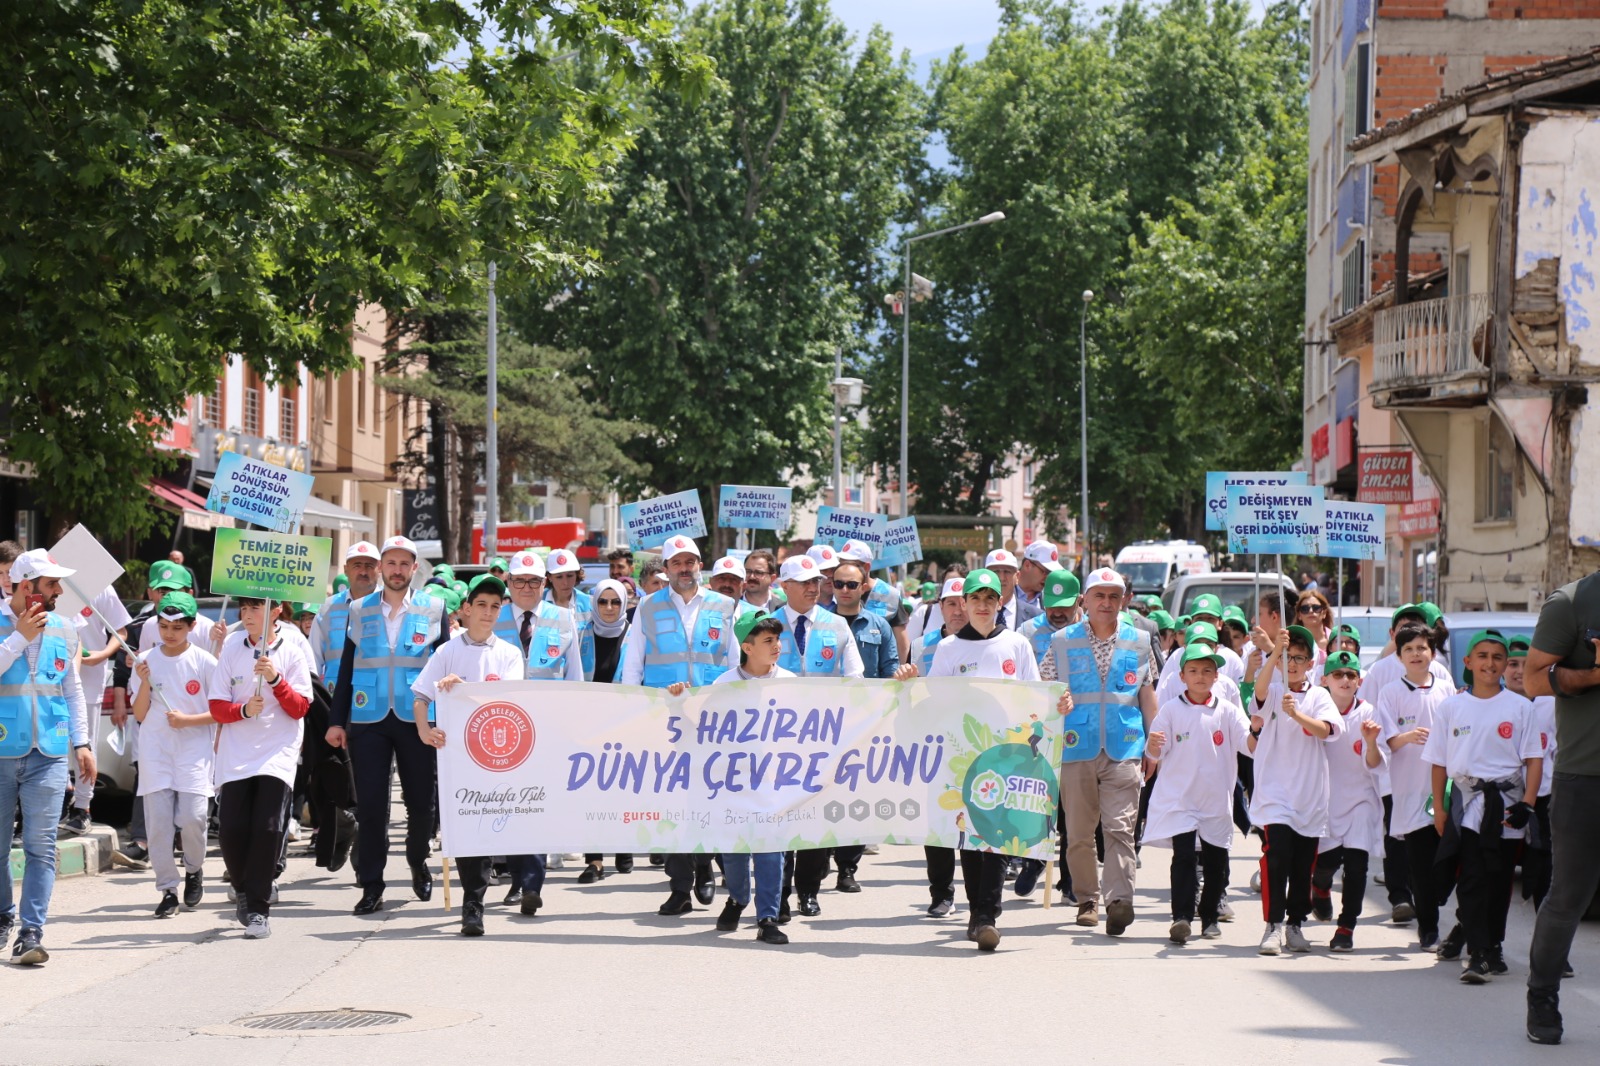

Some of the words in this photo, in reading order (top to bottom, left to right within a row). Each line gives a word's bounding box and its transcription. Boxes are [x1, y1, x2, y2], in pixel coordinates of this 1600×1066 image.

[243, 463, 288, 482] ATIKLAR
[1363, 454, 1408, 473] GÜVEN
[231, 471, 291, 498] DÖNÜŞSÜN,
[1361, 473, 1410, 488] EMLAK
[233, 485, 283, 507] DOĞAMIZ
[723, 499, 738, 507] BİR
[740, 501, 767, 509] ÇEVRE
[768, 501, 787, 510] İÇİN
[737, 491, 775, 500] SAĞLIKLI
[1239, 493, 1312, 509] DEĞİŞMEYEN
[231, 497, 275, 517] GÜLSÜN.
[640, 500, 683, 516] SAĞLIKLI
[628, 517, 644, 529] BİR
[646, 511, 676, 526] ÇEVRE
[677, 506, 698, 519] İÇİN
[830, 513, 852, 524] HER
[853, 516, 874, 528] ŞEY
[1254, 511, 1275, 520] TEK
[1278, 511, 1299, 523] ŞEY
[1335, 511, 1374, 522] ATIKLA
[409, 522, 438, 540] Cafe
[817, 525, 838, 537] ÇÖP
[838, 529, 883, 543] DEĞİLDİR.
[1345, 533, 1381, 545] OLSUN.
[239, 539, 282, 554] TEMİZ
[284, 542, 308, 557] BİR
[513, 537, 543, 547] Bankası
[885, 535, 916, 547] KORUR
[232, 554, 279, 569] ÇEVRE
[281, 555, 312, 573] İÇİN
[226, 566, 316, 587] YÜRÜYORUZ
[470, 710, 490, 733] GÜRSU
[490, 707, 529, 732] BELEDİYESİ
[666, 716, 683, 743] 5
[696, 698, 845, 746] HAZİRAN
[492, 758, 509, 766] 1930
[566, 742, 692, 794] DÜNYA
[702, 751, 829, 800] ÇEVRE
[833, 734, 945, 792] GÜNÜ
[1007, 777, 1047, 796] SIFIR
[455, 786, 516, 806] Mustafa
[1005, 792, 1047, 814] ATIK
[458, 808, 480, 816] Gürsu
[482, 807, 513, 815] Belediye
[514, 806, 545, 815] Başkanı
[585, 810, 700, 823] www.gursu.bel.tr
[724, 810, 749, 825] Bizi
[752, 811, 783, 827] Takip
[787, 807, 816, 822] Edin!
